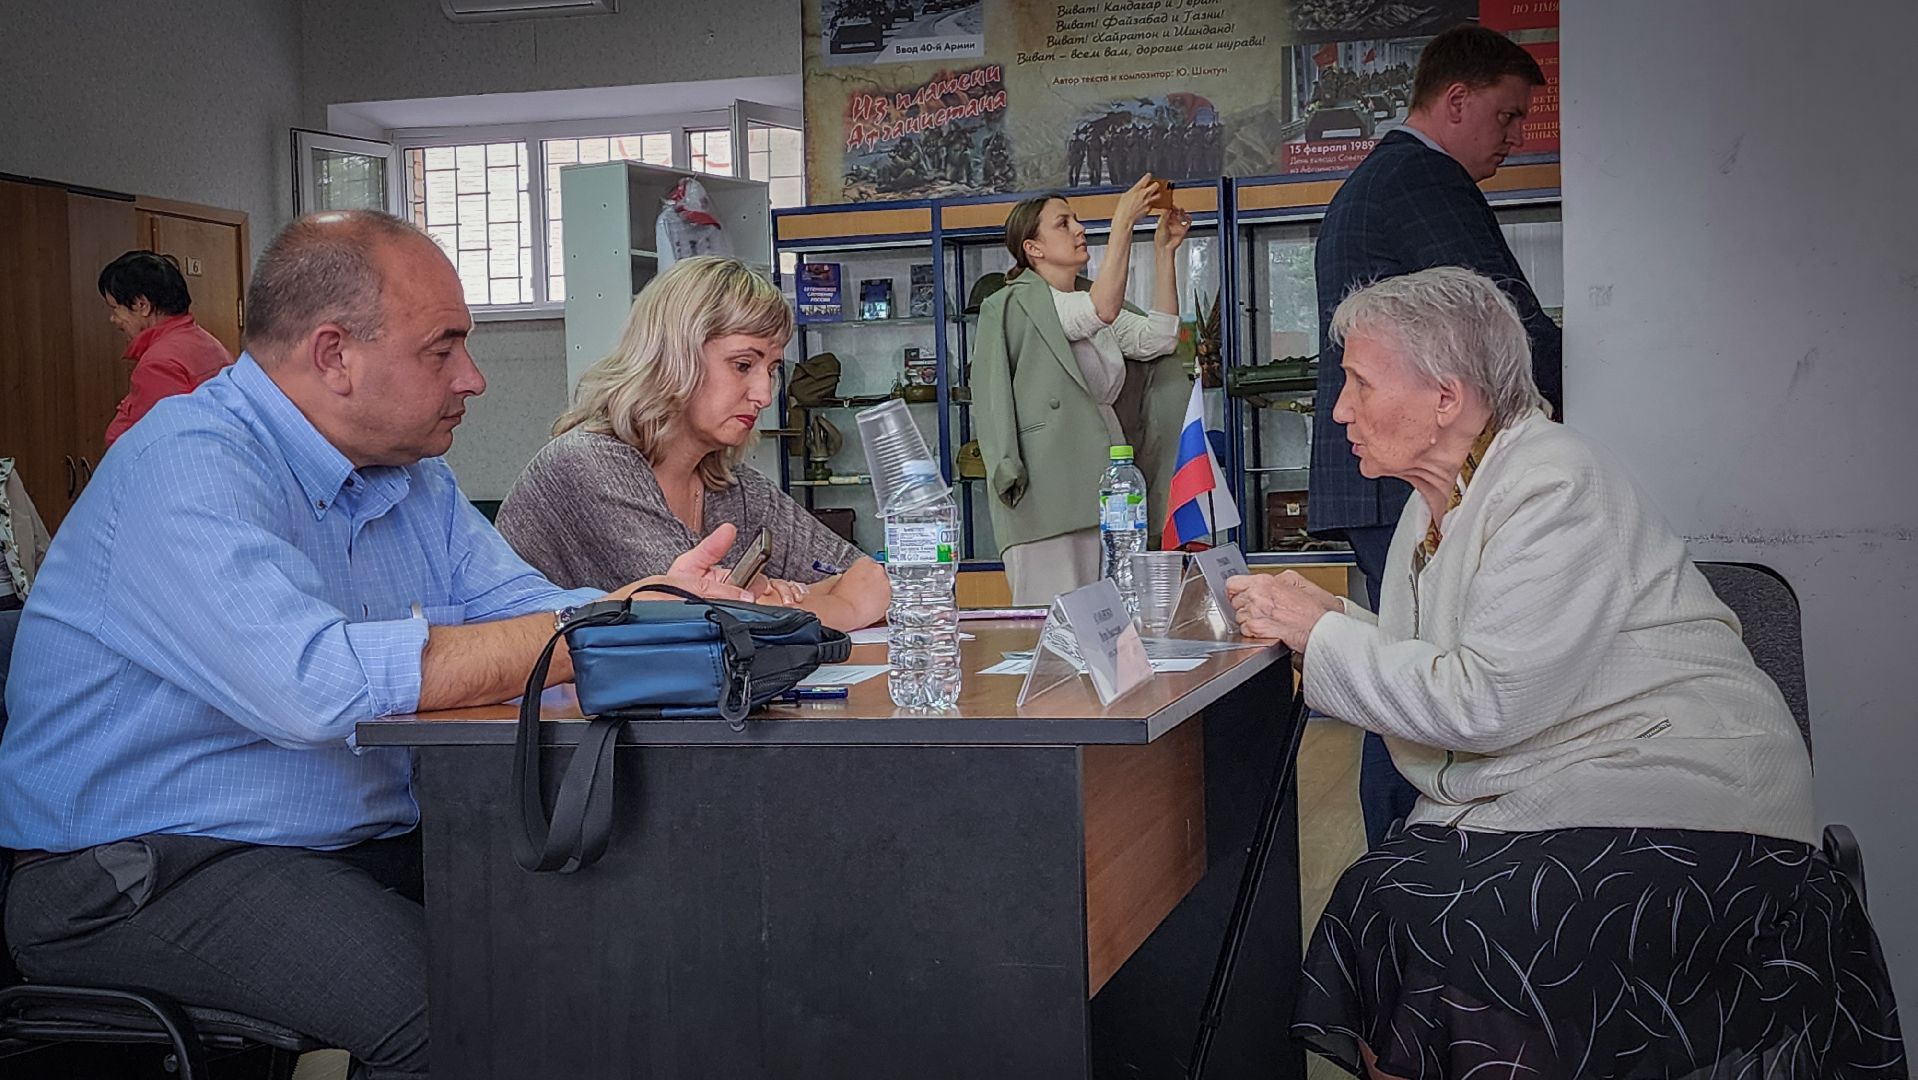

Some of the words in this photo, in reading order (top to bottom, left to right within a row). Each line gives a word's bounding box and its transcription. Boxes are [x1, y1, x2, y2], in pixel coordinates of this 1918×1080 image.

[1057, 3, 1099, 18] Виват!
[1104, 0, 1161, 12] Кандагар
[1056, 18, 1098, 32] Виват!
[1102, 12, 1168, 29] Файзабад
[1183, 9, 1225, 23] Газни!
[1046, 34, 1089, 48] Виват!
[1092, 30, 1158, 43] Хайратон
[1162, 29, 1170, 38] и
[1174, 22, 1236, 37] Шинданд!
[895, 45, 919, 54] Ввод
[920, 43, 942, 52] 40-й
[944, 42, 976, 53] Армии
[1016, 51, 1056, 65] Виват
[1070, 48, 1100, 59] всем
[1104, 46, 1132, 57] вам,
[1136, 44, 1183, 56] дорогие
[1187, 43, 1213, 51] мои
[1216, 35, 1266, 50] шурави!
[1053, 76, 1080, 86] Автор
[1081, 74, 1108, 83] текста
[851, 93, 889, 125] Из
[894, 64, 1001, 112] пламени
[846, 91, 1007, 152] Афганистана
[1290, 145, 1301, 154] 15
[1303, 144, 1347, 156] февраля
[1350, 140, 1375, 151] 1989
[192, 260, 199, 273] 6
